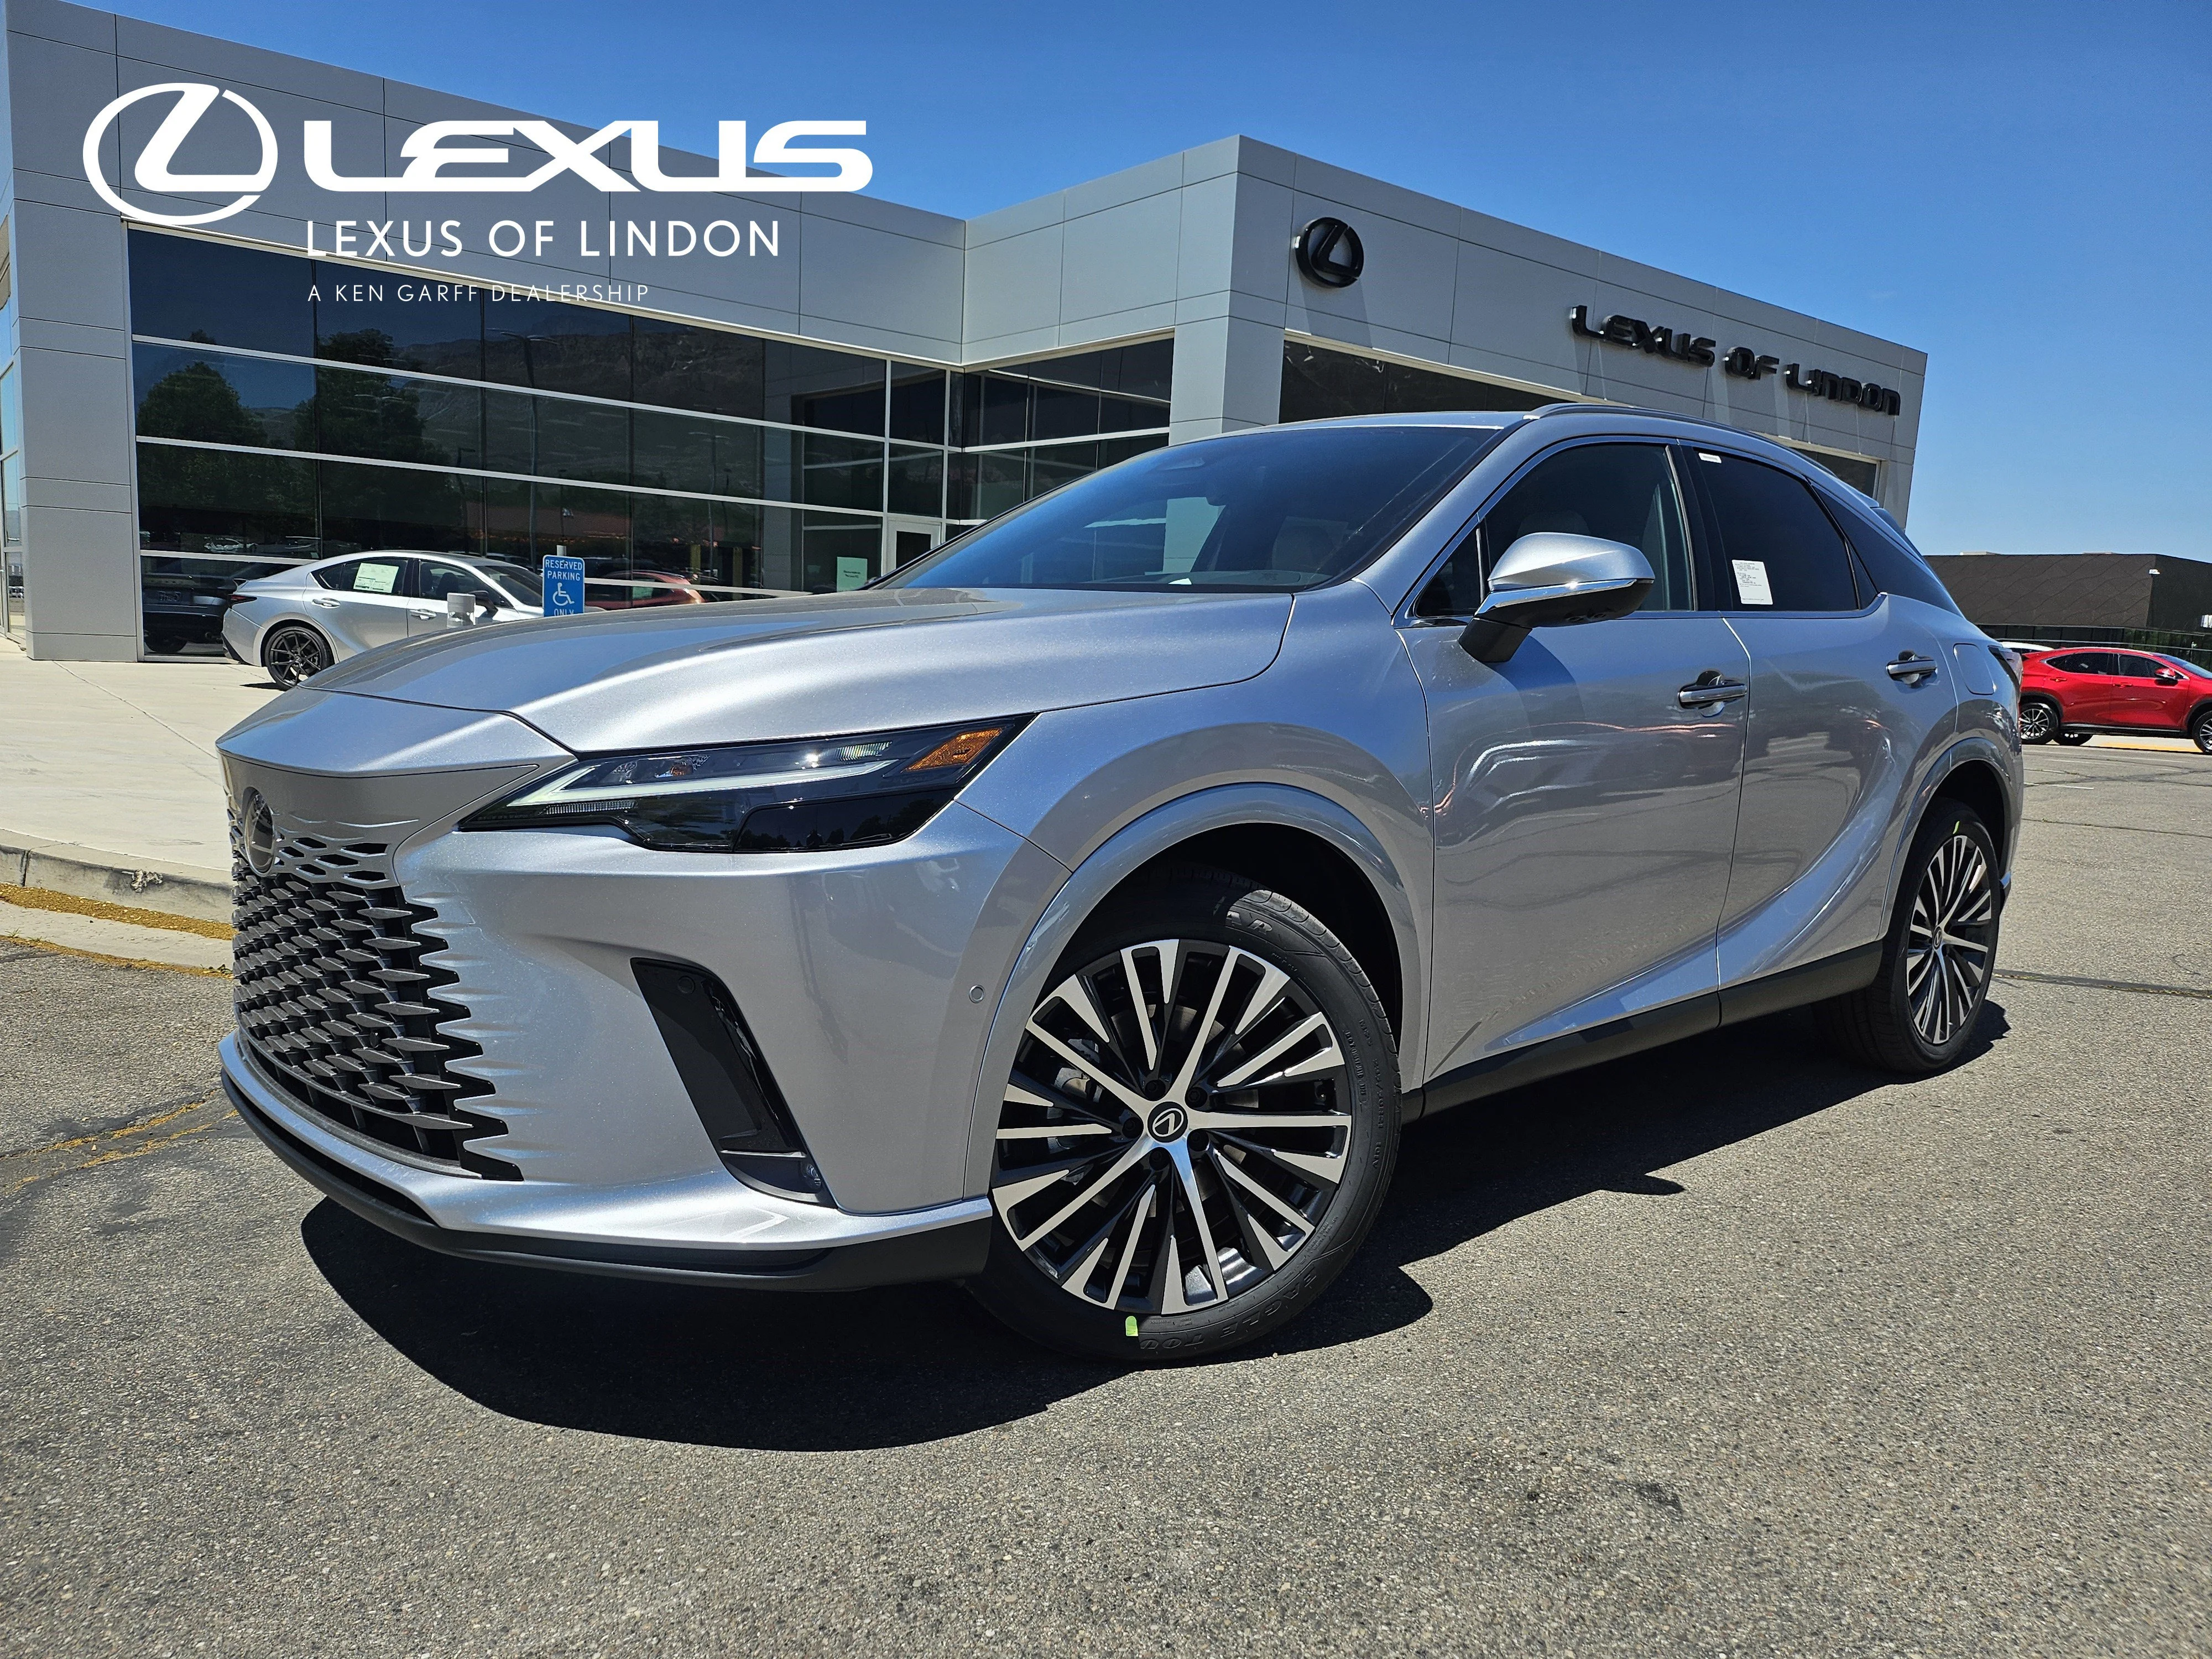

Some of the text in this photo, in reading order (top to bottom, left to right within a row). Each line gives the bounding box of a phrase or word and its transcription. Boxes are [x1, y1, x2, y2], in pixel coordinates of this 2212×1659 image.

[1572, 305, 1901, 415] LEXUS OF LINDON
[545, 559, 582, 570] RESERVED
[547, 570, 581, 581] PARKING
[1220, 1266, 1317, 1338] EAGLE
